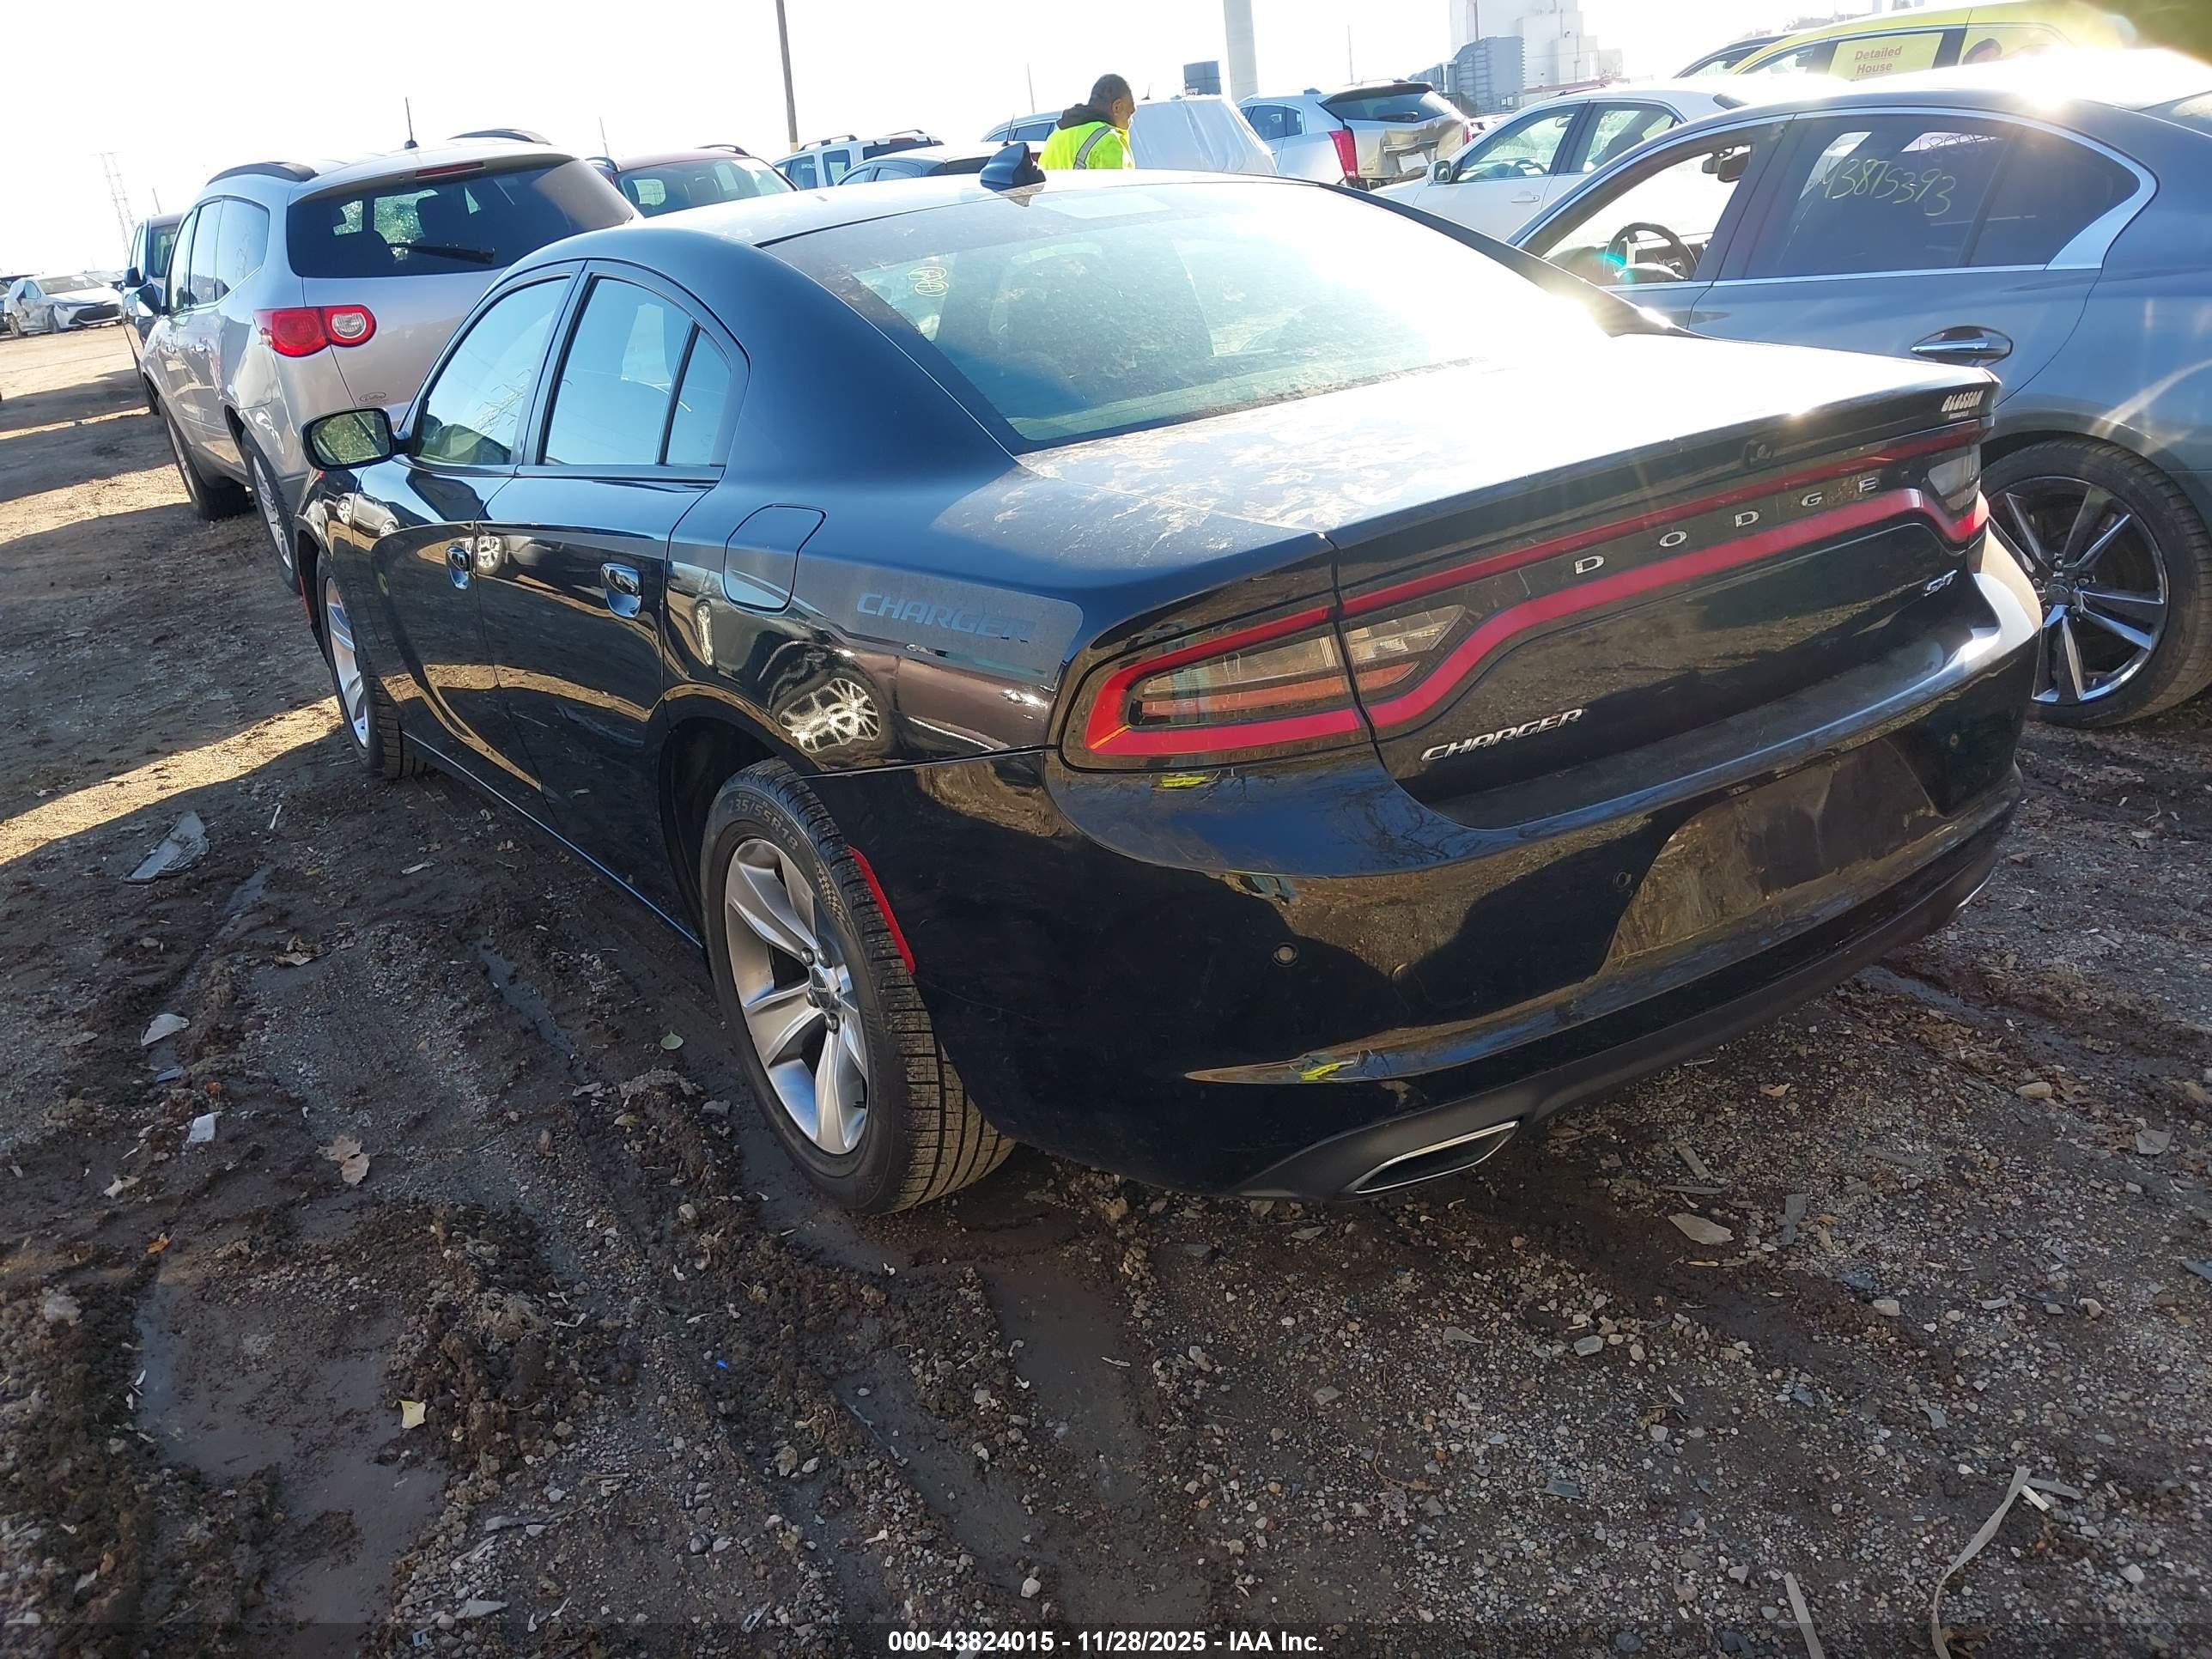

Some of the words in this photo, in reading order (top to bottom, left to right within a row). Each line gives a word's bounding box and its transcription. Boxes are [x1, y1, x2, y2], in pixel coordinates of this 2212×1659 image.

[1855, 46, 1903, 61] Detailed
[1856, 63, 1893, 75] House
[1575, 477, 1877, 574] DODGE
[857, 590, 1036, 643] CHARGER
[1420, 708, 1583, 762] CHARGER
